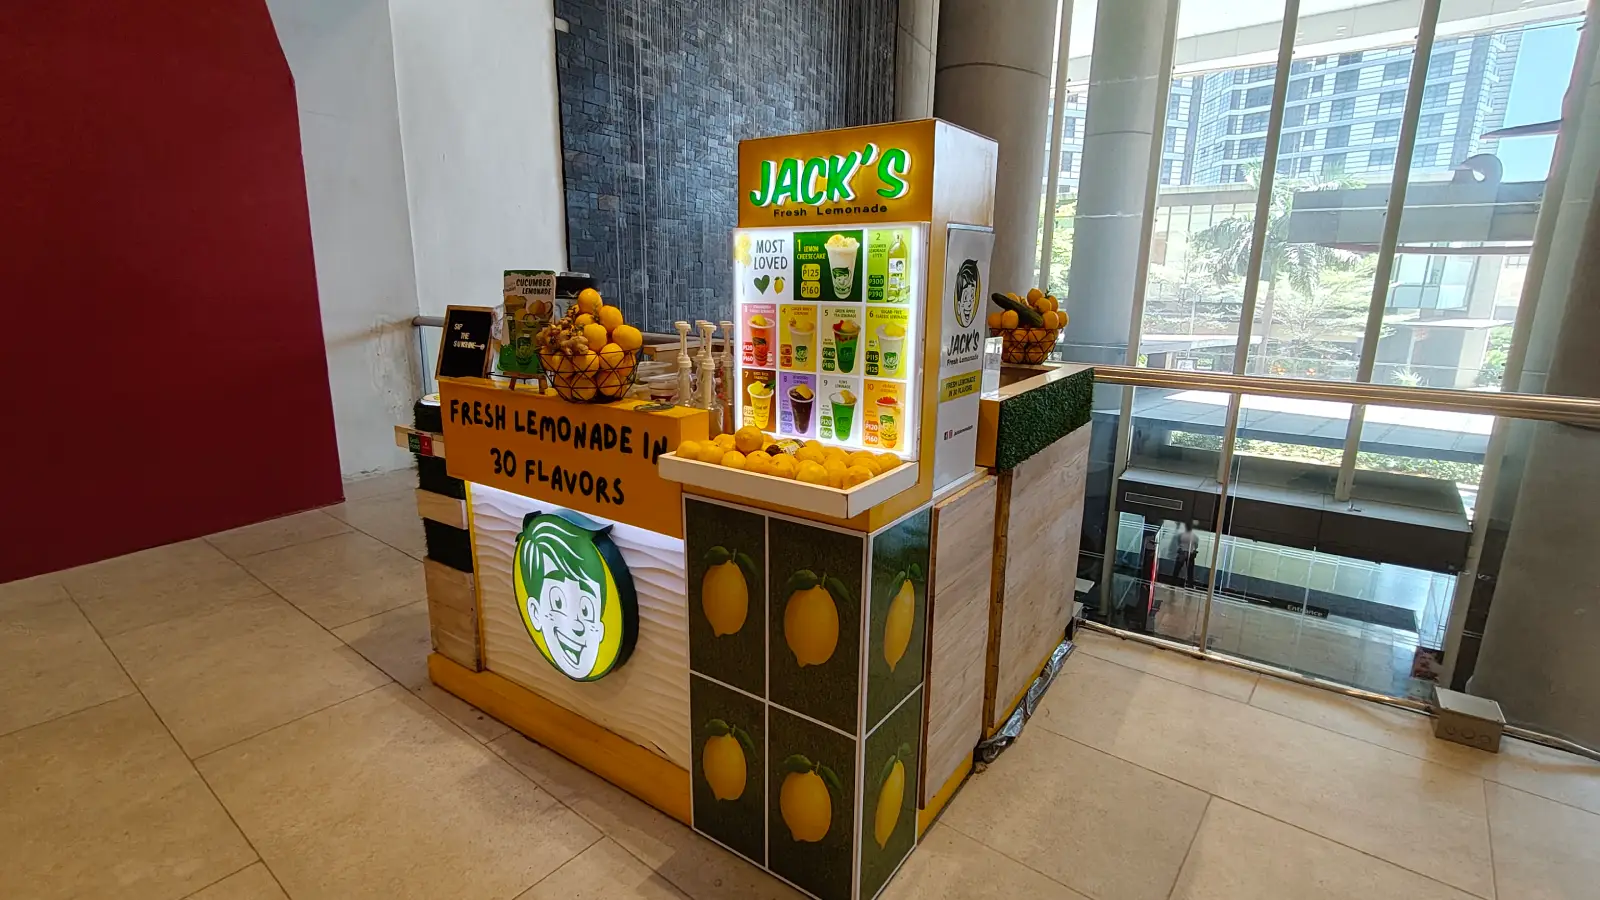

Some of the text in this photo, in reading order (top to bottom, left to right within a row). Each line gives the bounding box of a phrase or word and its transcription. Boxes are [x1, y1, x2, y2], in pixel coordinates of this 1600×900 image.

[750, 142, 912, 206] JACK'S
[773, 204, 888, 217] Fresh Lemonade
[875, 233, 881, 241] 2
[756, 239, 785, 254] MOST
[797, 239, 819, 253] 1 LEMON
[796, 252, 826, 260] CHEESECAKE
[753, 256, 788, 270] LOVED
[515, 278, 551, 287] CUCUMBER
[521, 287, 552, 296] LEMONADE
[824, 309, 829, 317] 5
[869, 310, 874, 318] 6
[460, 332, 471, 340] THE
[947, 329, 979, 356] JACK'S
[946, 358, 958, 367] Fresh
[959, 354, 979, 364] Lemonade
[823, 379, 828, 387] 9
[867, 383, 874, 391] 10
[946, 376, 976, 390] FRESH LEMONADE
[450, 399, 668, 466] FRESH LEMONADE IN
[490, 447, 625, 506] 30 FLAVORS
